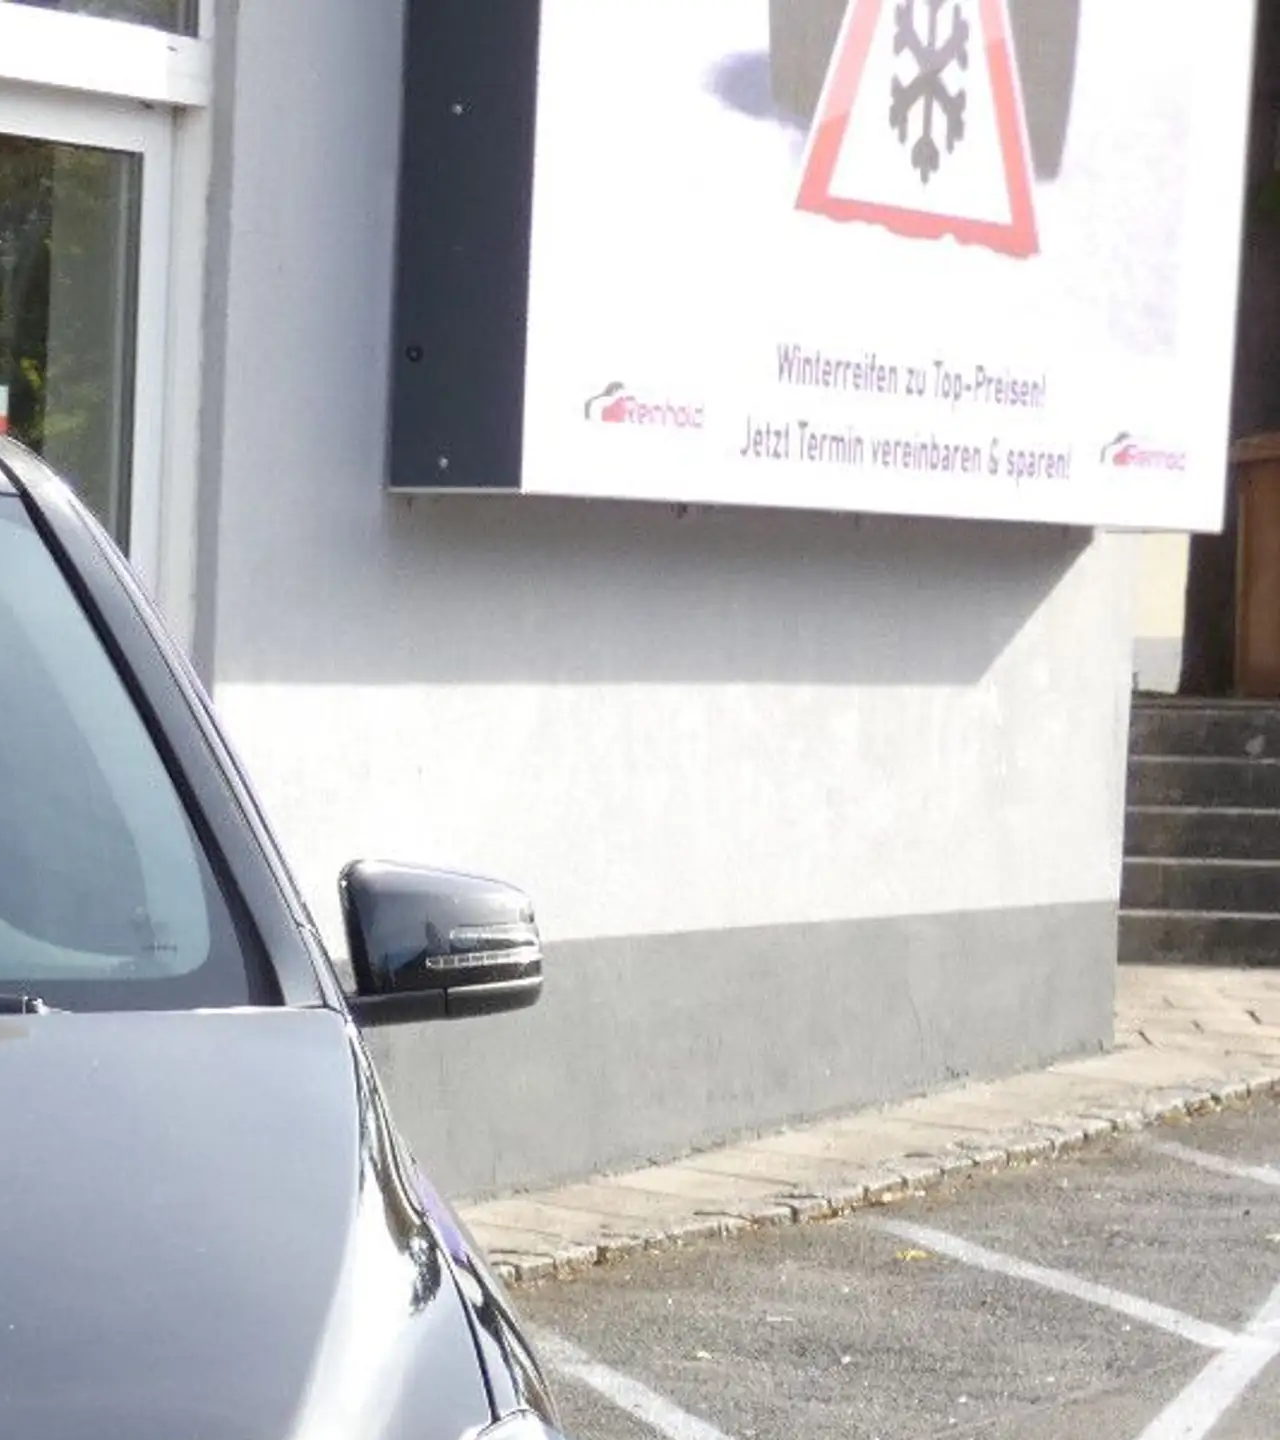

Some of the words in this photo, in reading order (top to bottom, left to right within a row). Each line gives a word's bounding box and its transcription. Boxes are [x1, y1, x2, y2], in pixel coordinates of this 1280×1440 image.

[776, 343, 898, 395] Winterreifen
[904, 366, 927, 397] zu
[932, 359, 1047, 412] Top-Preisen!
[739, 413, 790, 460] Jetzt
[797, 418, 864, 465] Termin
[870, 432, 982, 474] vereinbaren
[1007, 443, 1073, 488] sparen!
